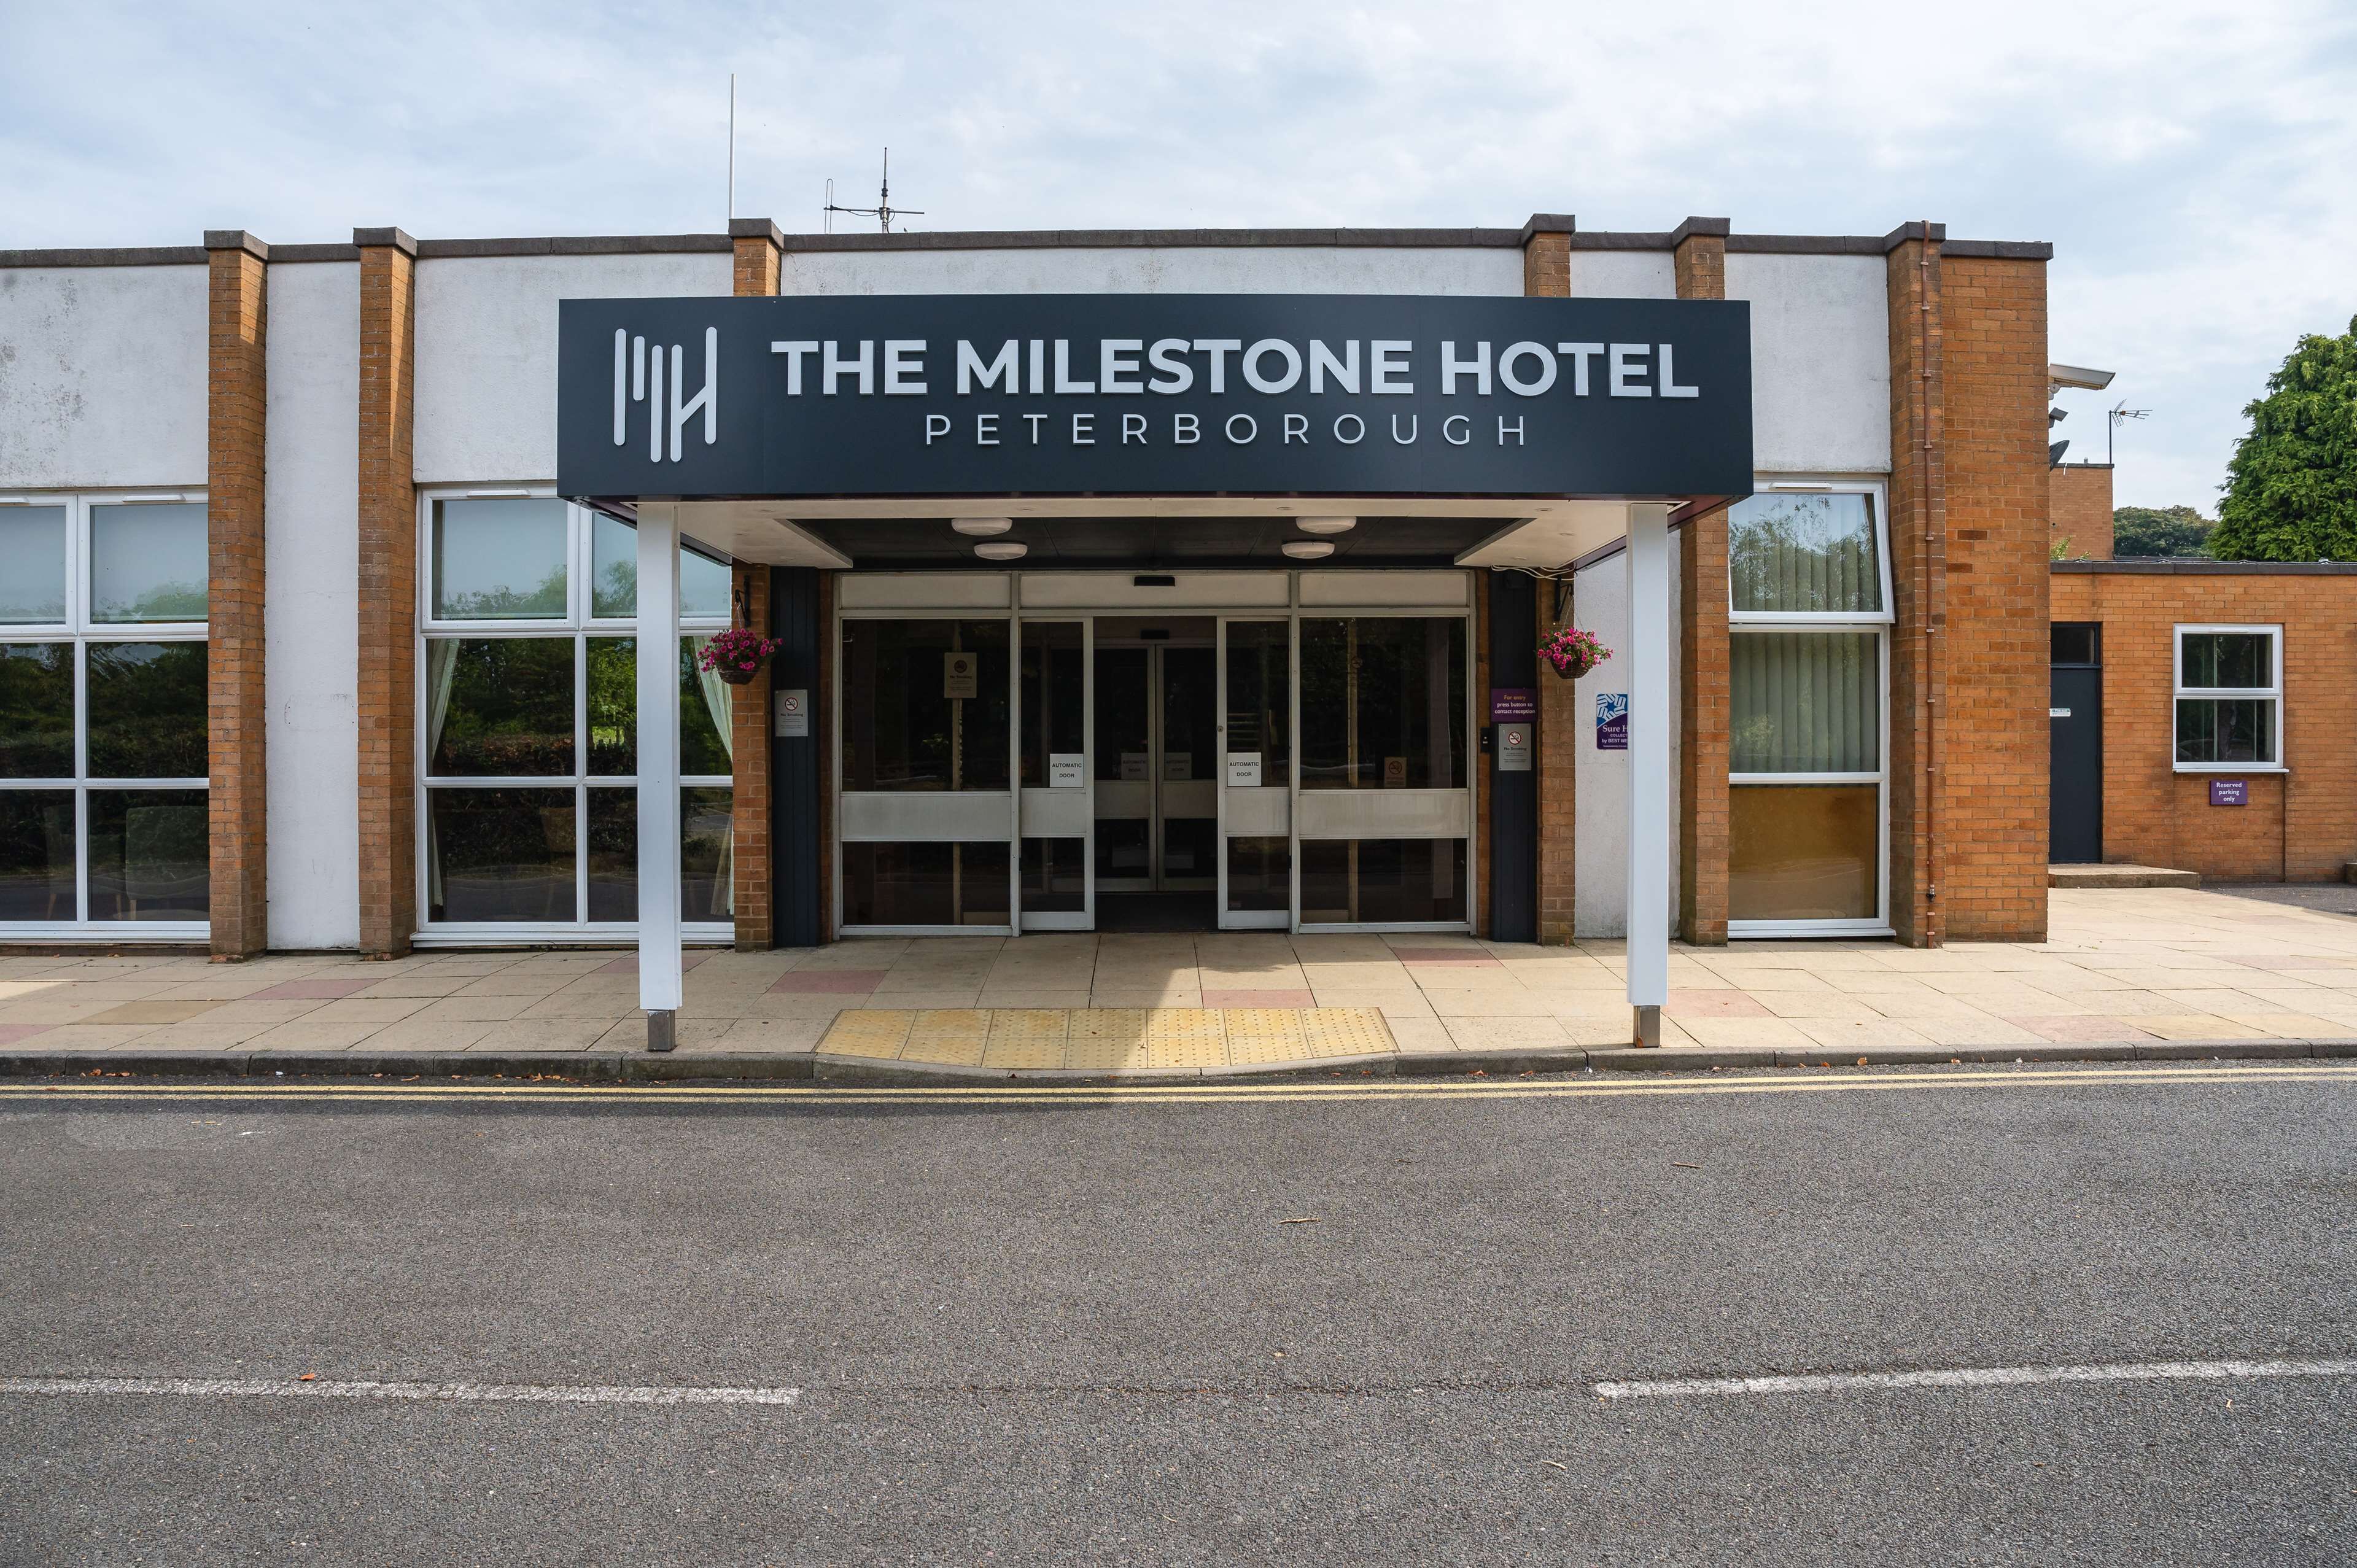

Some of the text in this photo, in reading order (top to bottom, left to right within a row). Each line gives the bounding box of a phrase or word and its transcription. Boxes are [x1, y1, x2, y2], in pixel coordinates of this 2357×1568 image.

[771, 338, 1699, 398] THE MILESTONE HOTEL
[926, 413, 1525, 446] PETERBOROUGH
